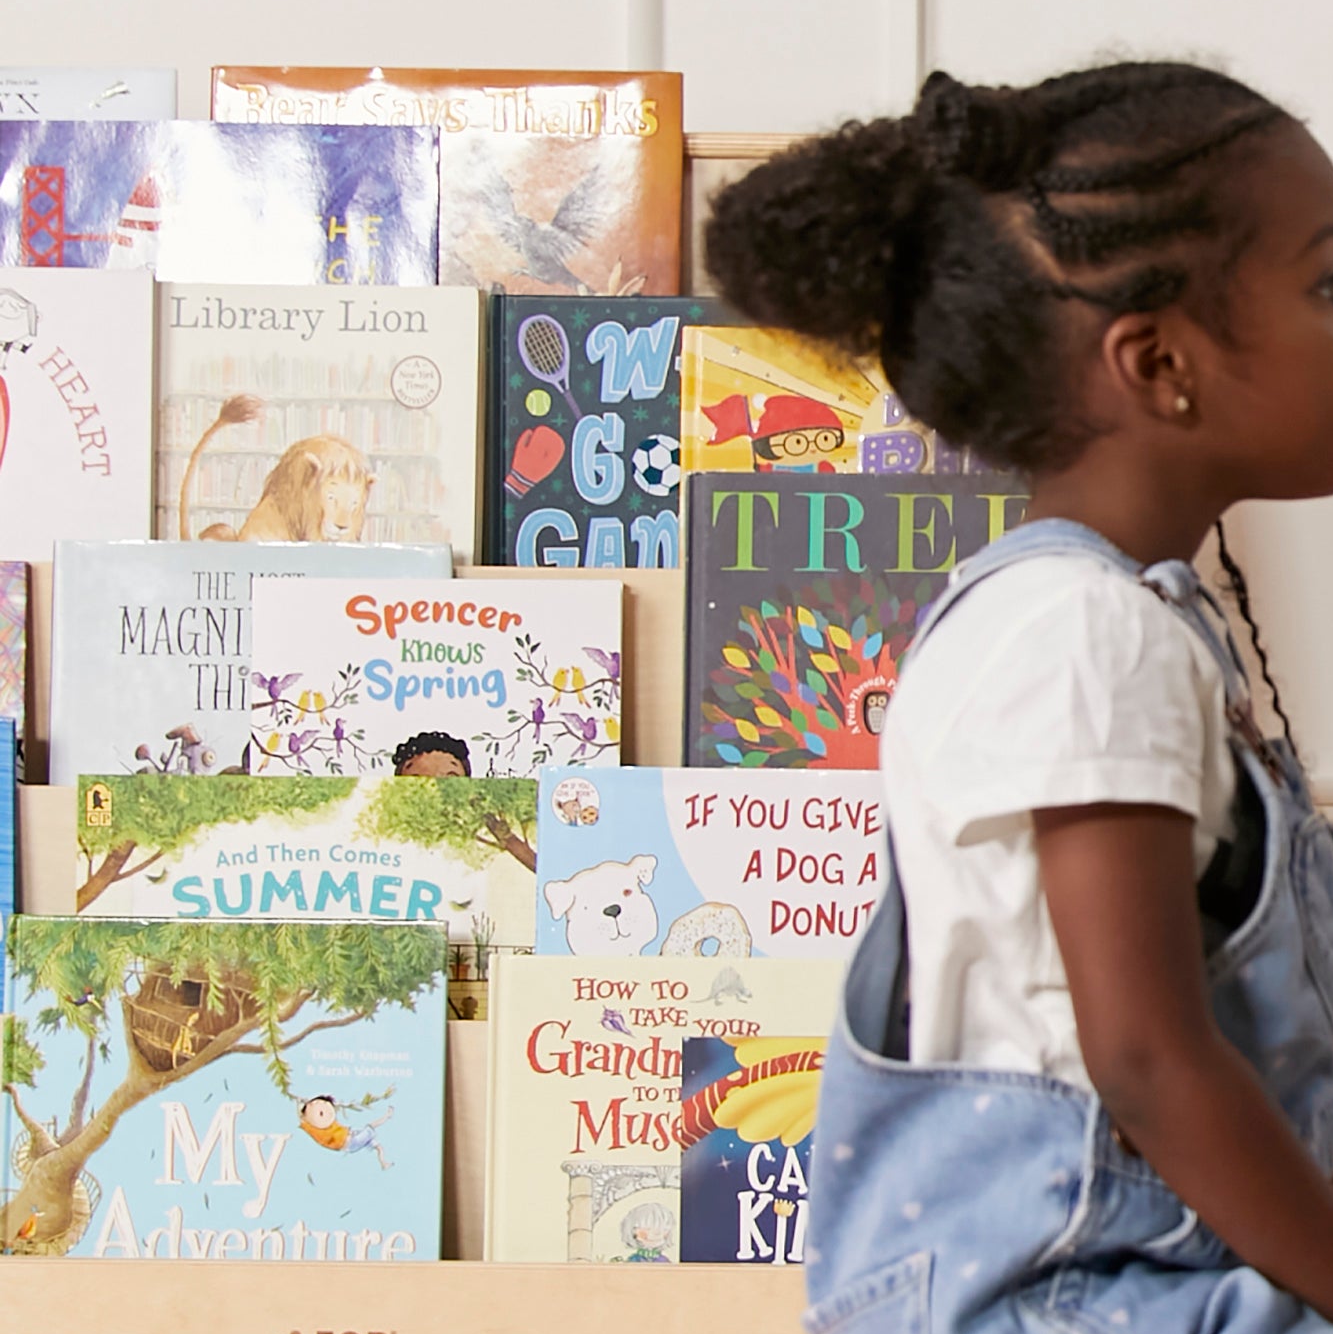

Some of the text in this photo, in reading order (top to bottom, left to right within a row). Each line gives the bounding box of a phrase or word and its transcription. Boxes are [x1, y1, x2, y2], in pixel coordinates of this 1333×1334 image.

[483, 85, 660, 137] Thanks
[170, 296, 430, 342] Library Lion
[38, 346, 112, 477] HEART
[192, 570, 236, 601] THE
[345, 594, 523, 640] Spencer
[363, 659, 508, 712] Spring
[684, 793, 883, 837] IF YOU GIVE
[216, 843, 402, 868] And Then Comes
[742, 847, 878, 886] A DOG A
[171, 869, 443, 921] SUMMER
[572, 978, 689, 1002] HOW TO
[629, 1007, 688, 1028] TAKE
[632, 1085, 660, 1103] TO
[154, 1101, 293, 1219] My
[94, 1185, 417, 1260] Adventure
